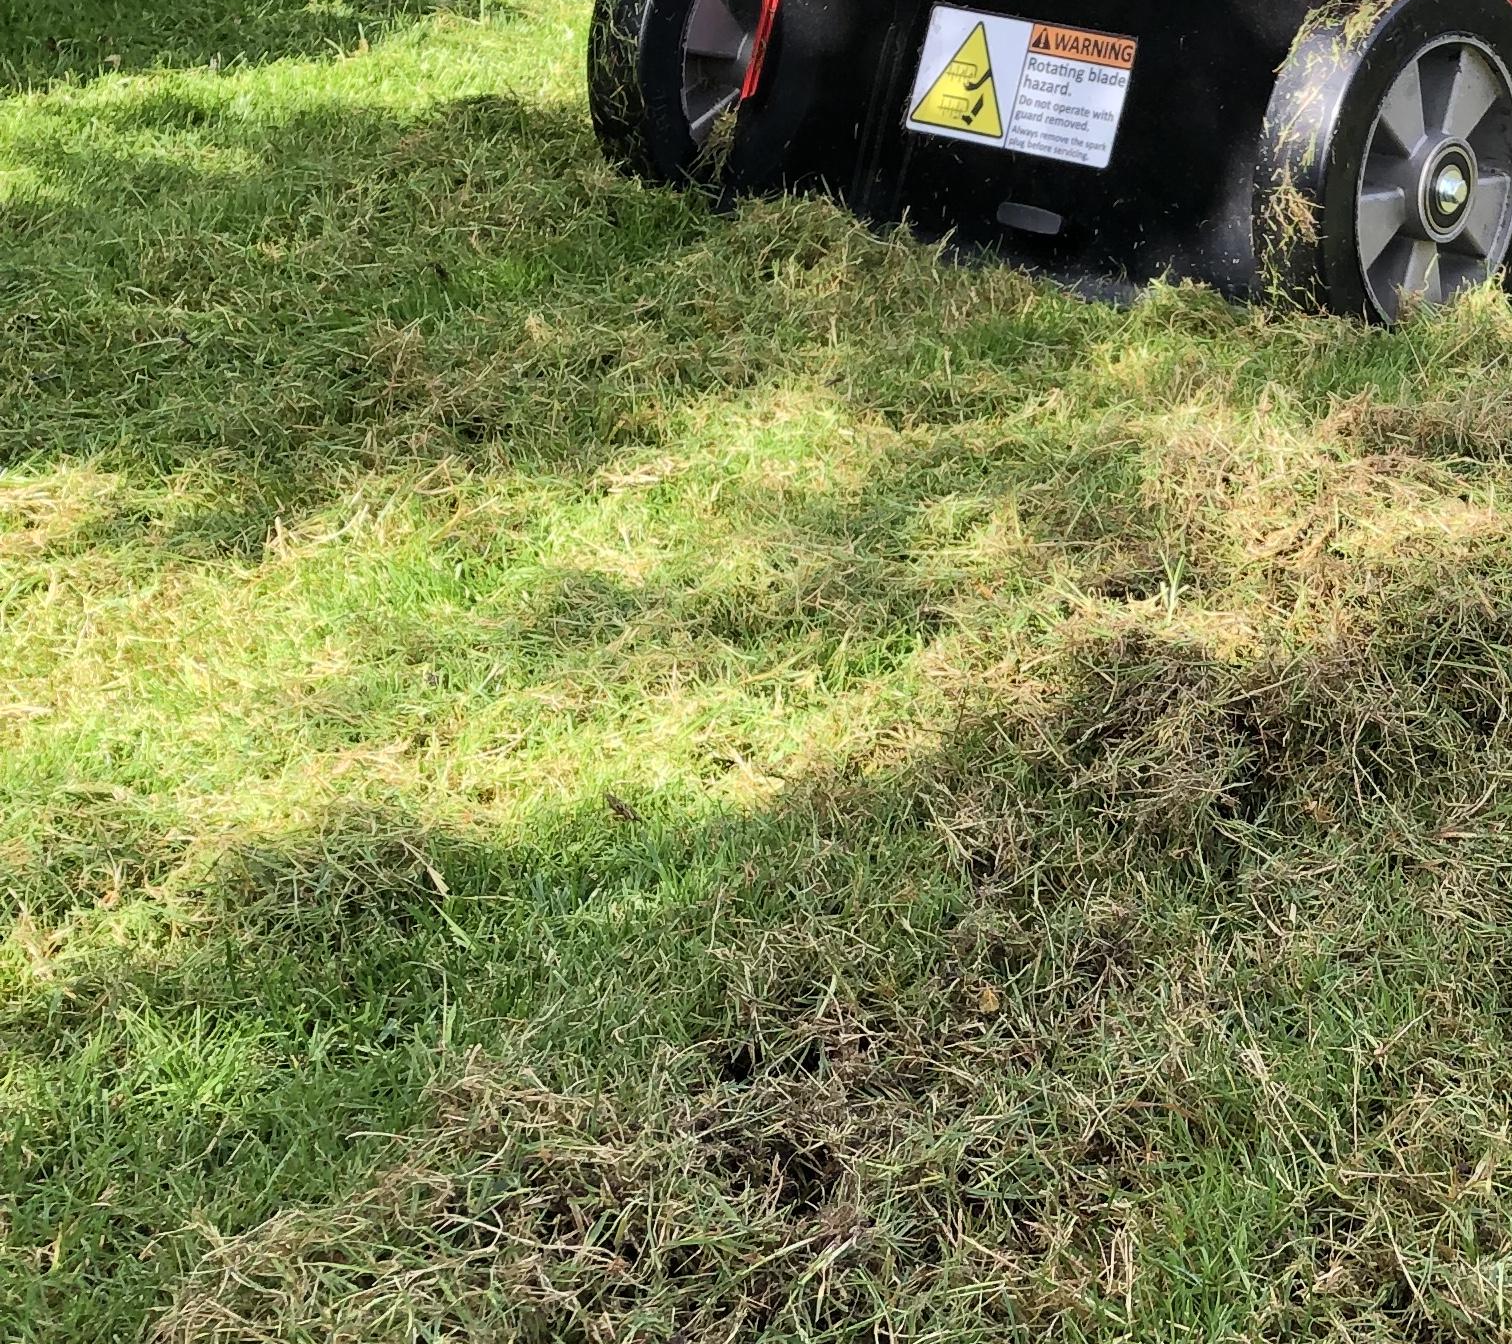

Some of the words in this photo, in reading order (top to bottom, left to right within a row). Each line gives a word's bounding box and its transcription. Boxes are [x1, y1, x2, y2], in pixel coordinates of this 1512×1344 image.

[1054, 33, 1133, 62] WARNING
[1023, 74, 1072, 97] hazard.
[1027, 57, 1085, 83] Rotating
[1088, 67, 1126, 87] blade
[1014, 109, 1044, 123] guard
[1044, 115, 1090, 132] removed.
[1018, 94, 1033, 106] Do
[1034, 98, 1051, 110] not
[1052, 103, 1090, 118] operate
[1092, 109, 1115, 122] with
[1008, 136, 1025, 149] plug
[1027, 140, 1052, 153] before
[1011, 125, 1038, 139] Always
[1040, 132, 1069, 145] remove
[1070, 136, 1084, 147] the
[1085, 140, 1107, 152] spark
